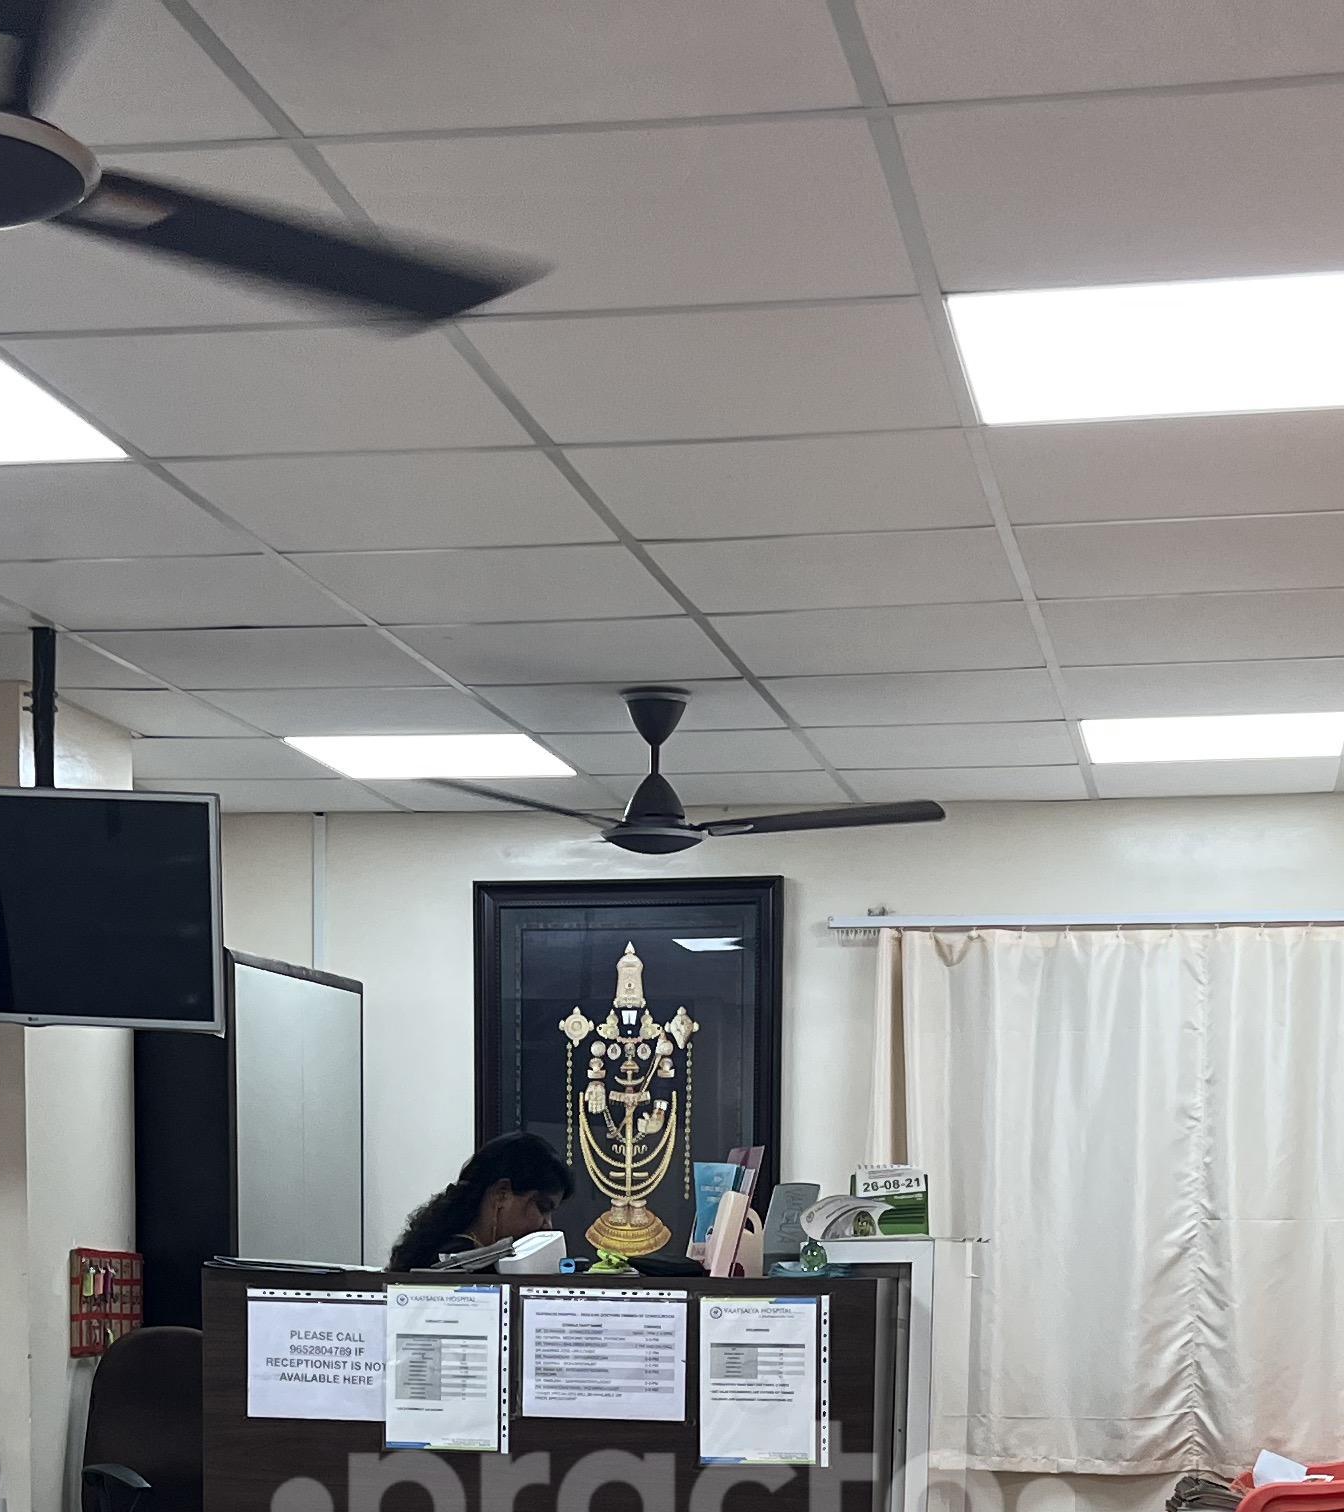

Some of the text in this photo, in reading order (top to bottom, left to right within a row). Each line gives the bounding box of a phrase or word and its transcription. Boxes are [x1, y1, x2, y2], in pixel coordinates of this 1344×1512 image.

[289, 1330, 365, 1343] PLEASE CALL
[354, 1347, 365, 1356] IF
[265, 1357, 348, 1370] RECEPTIONIST
[350, 1361, 362, 1371] IS
[279, 1372, 374, 1385] AVAILABLE HERE
